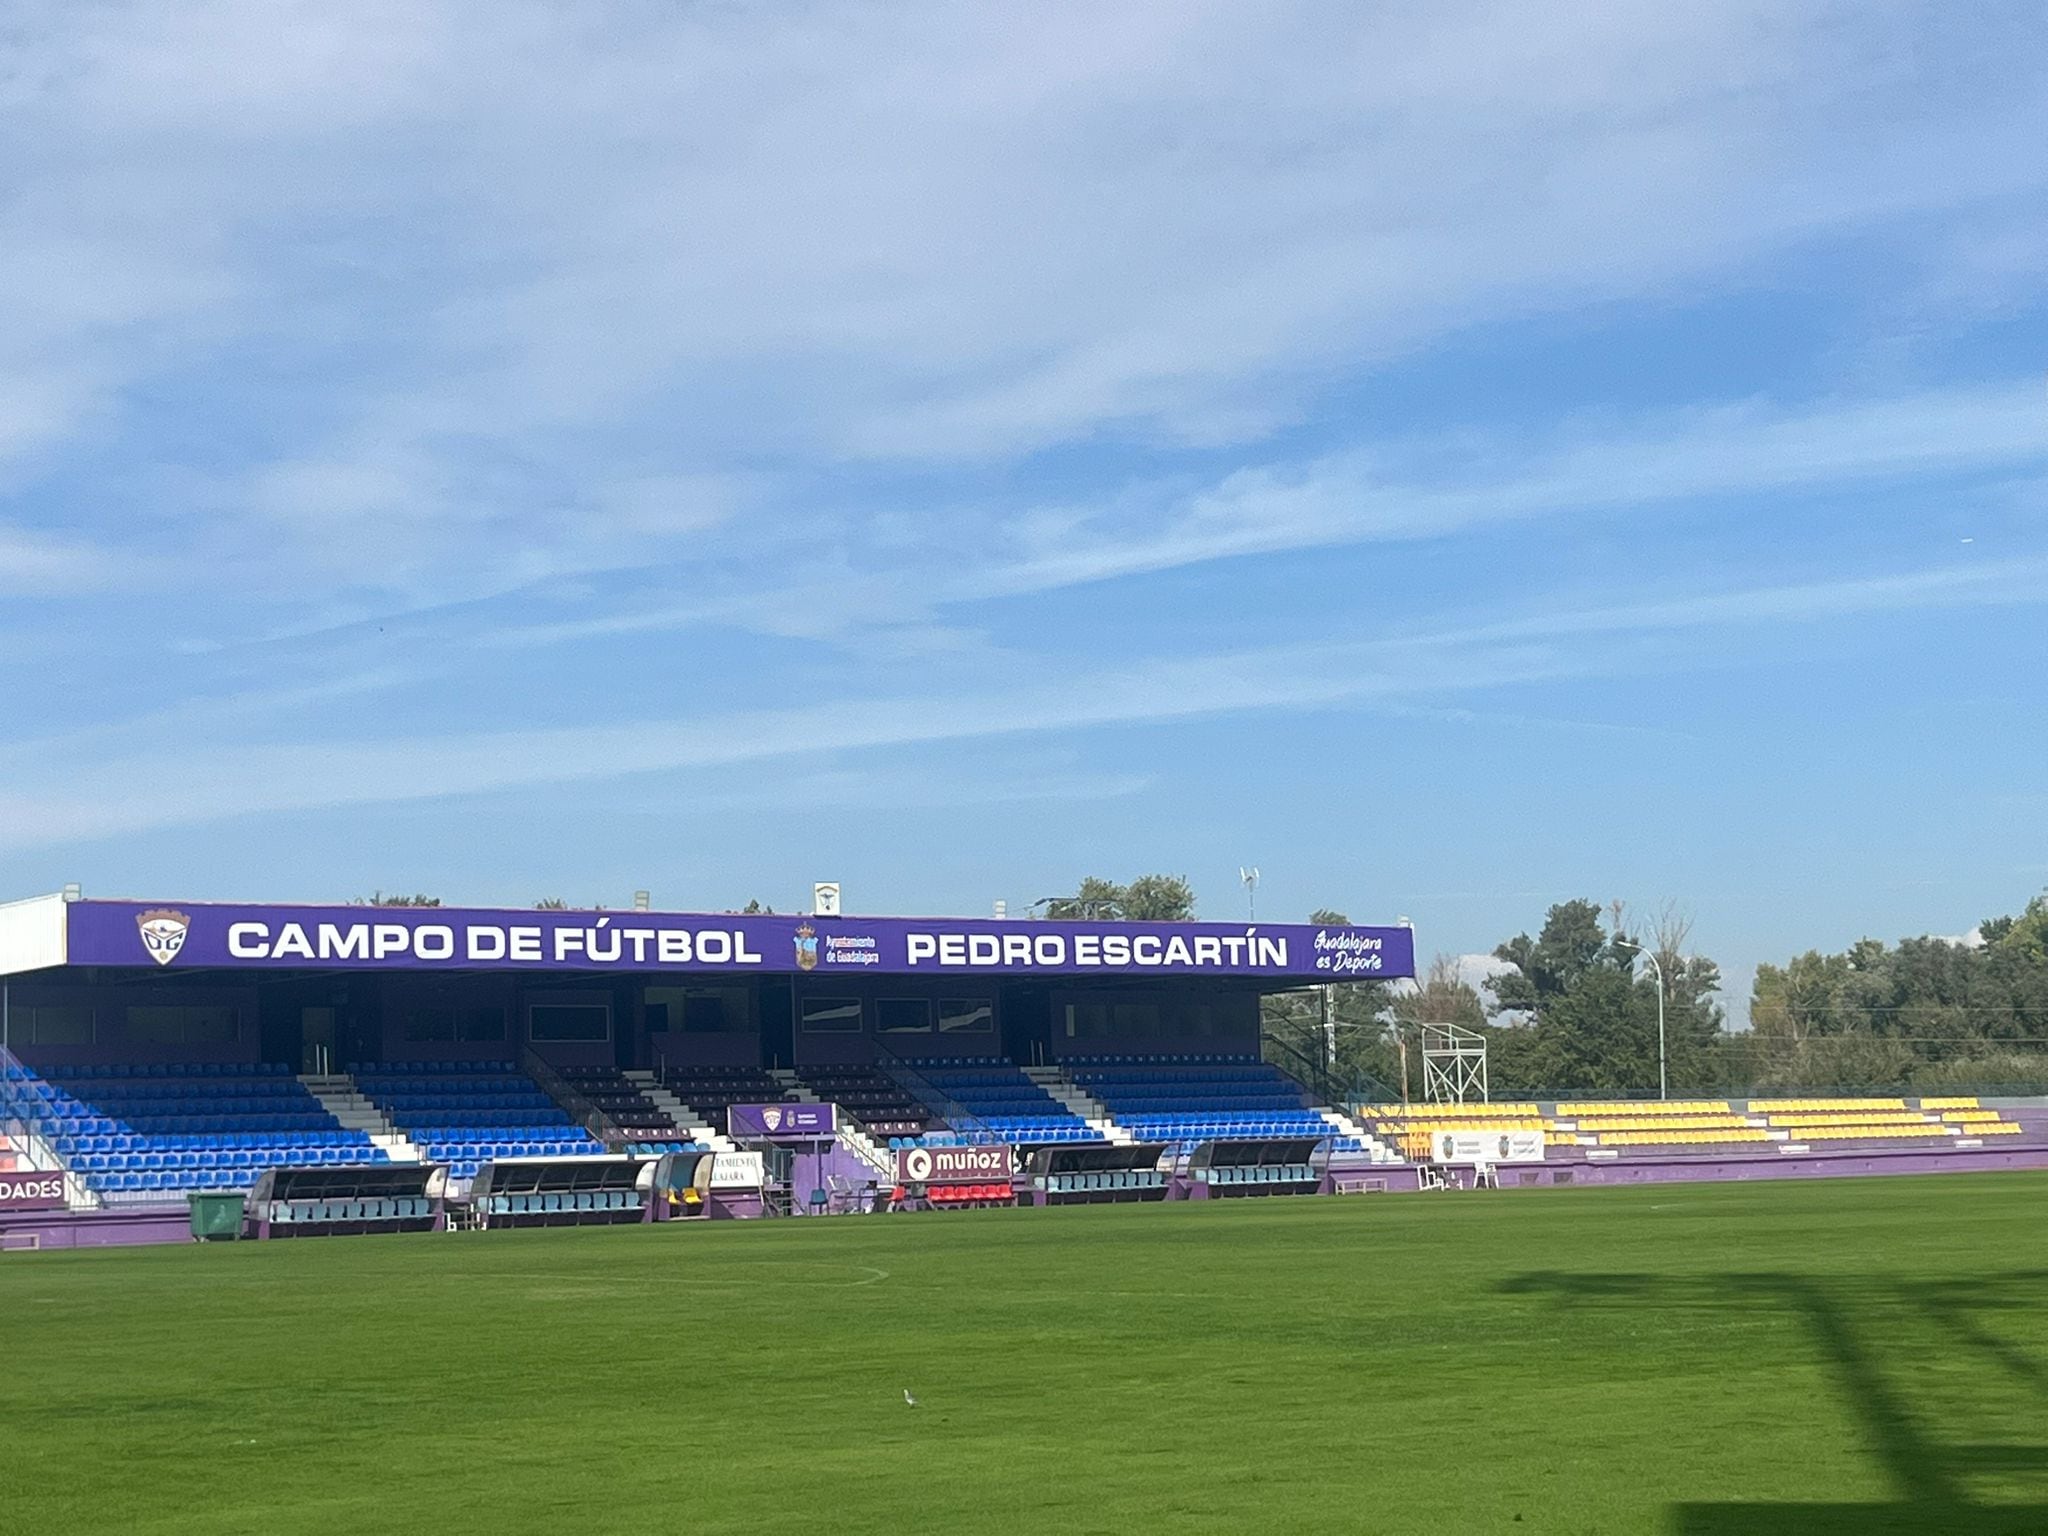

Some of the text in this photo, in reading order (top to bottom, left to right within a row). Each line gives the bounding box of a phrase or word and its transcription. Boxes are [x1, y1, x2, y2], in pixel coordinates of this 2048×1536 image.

[228, 917, 762, 963] CAMPO DE FÚTBOL
[906, 927, 1288, 967] PEDRO ESCARTÍN
[1314, 929, 1382, 955] Guadalajara
[826, 950, 879, 966] de Guadalajara
[1316, 950, 1382, 974] es Deporte
[936, 1147, 1002, 1170] muñoz
[0, 1180, 62, 1200] DADES
